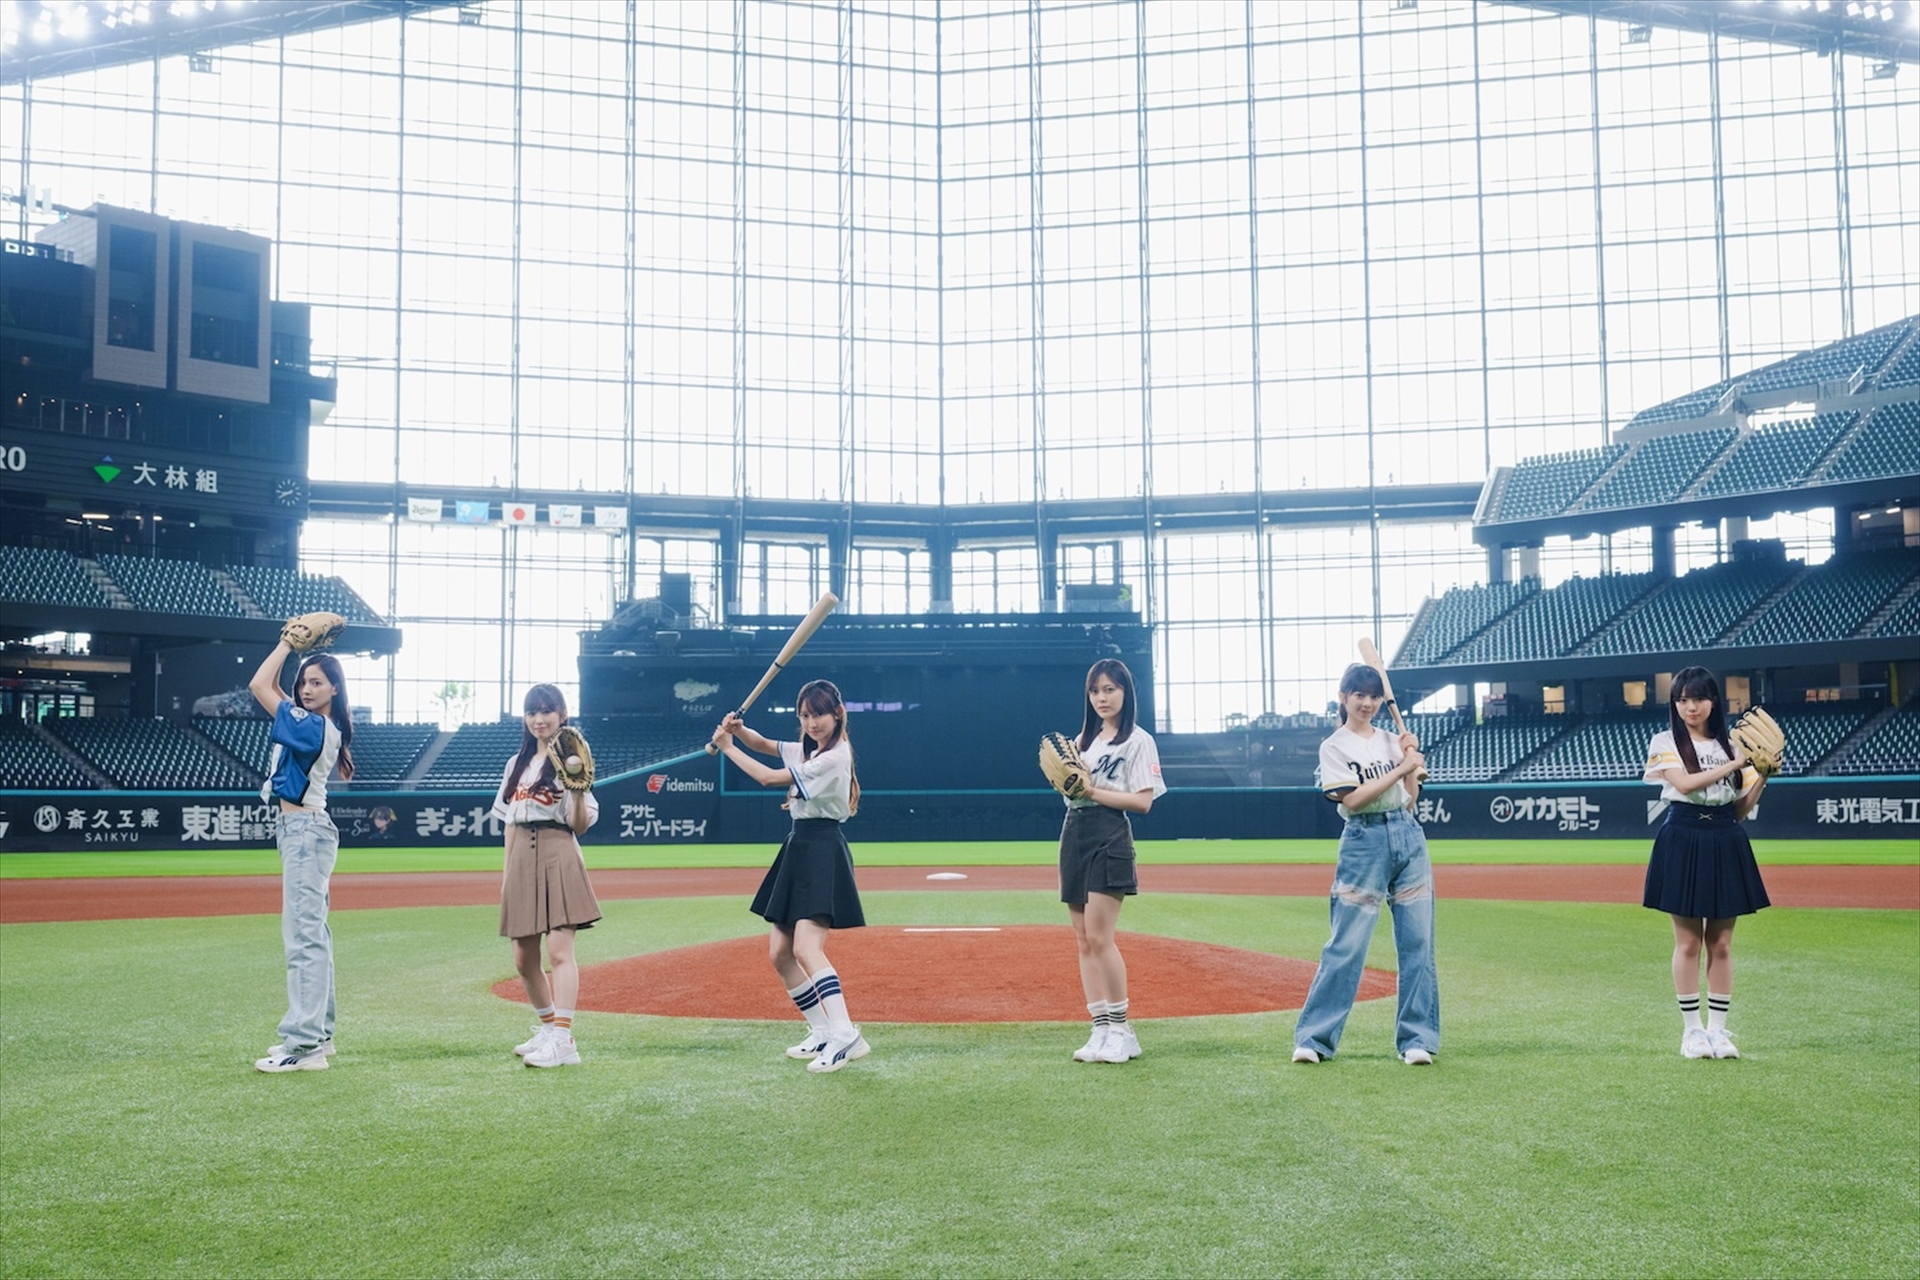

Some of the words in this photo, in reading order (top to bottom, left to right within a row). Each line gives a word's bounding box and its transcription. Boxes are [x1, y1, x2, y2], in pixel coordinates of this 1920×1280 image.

[133, 461, 218, 493] 大林組
[1091, 754, 1124, 779] M
[666, 778, 714, 792] idemitsu
[620, 805, 655, 818] アサヒ
[1411, 798, 1451, 823] まん
[1514, 796, 1600, 820] オカモト
[1816, 797, 1920, 823] 東光電気工
[181, 805, 240, 841] 東進
[620, 820, 707, 837] スーパードライ
[1558, 820, 1600, 831] グループ
[84, 832, 139, 842] SAIKYU
